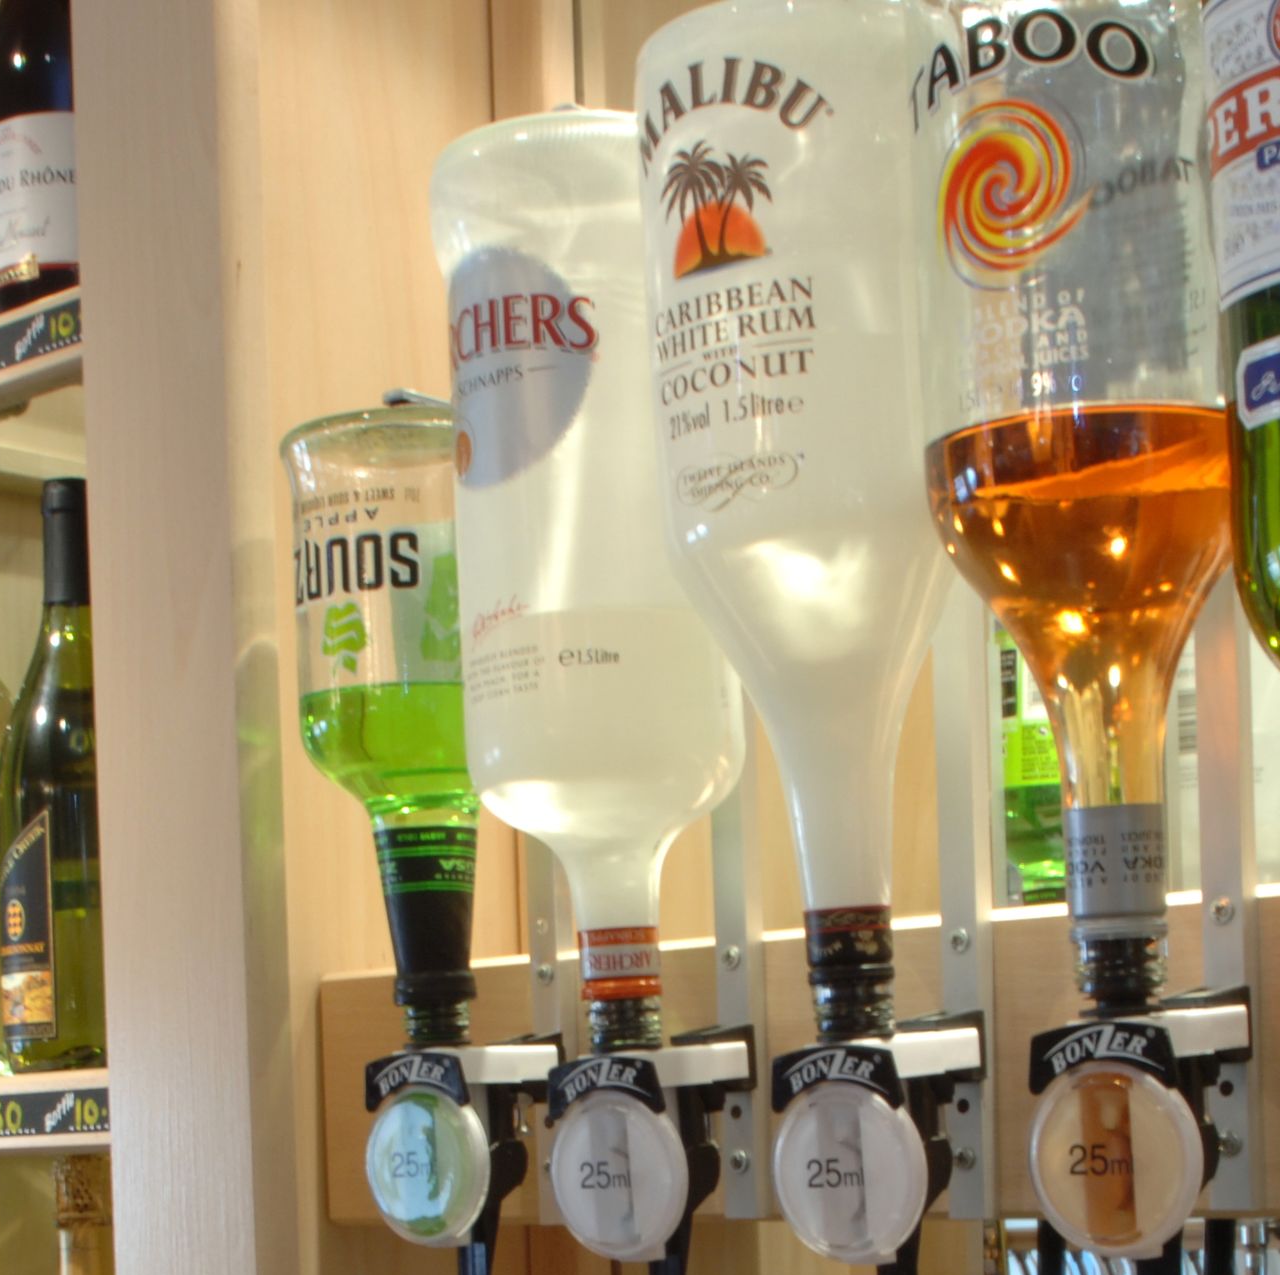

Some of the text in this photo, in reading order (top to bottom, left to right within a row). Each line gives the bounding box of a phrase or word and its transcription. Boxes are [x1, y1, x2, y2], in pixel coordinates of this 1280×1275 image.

[451, 292, 597, 370] CHERS
[655, 276, 813, 338] CARIBBEAN
[657, 304, 816, 364] WHITE RUM
[661, 348, 814, 407] COCONUT
[294, 530, 419, 608] SOURZ
[789, 1049, 876, 1095] BONZER
[1050, 1024, 1148, 1076] BONZER
[379, 1055, 446, 1097] BONZER
[564, 1057, 638, 1102] BONZER
[580, 1161, 632, 1189] 25ml
[807, 1158, 865, 1189] 25ml
[1070, 1144, 1134, 1176] 25ml
